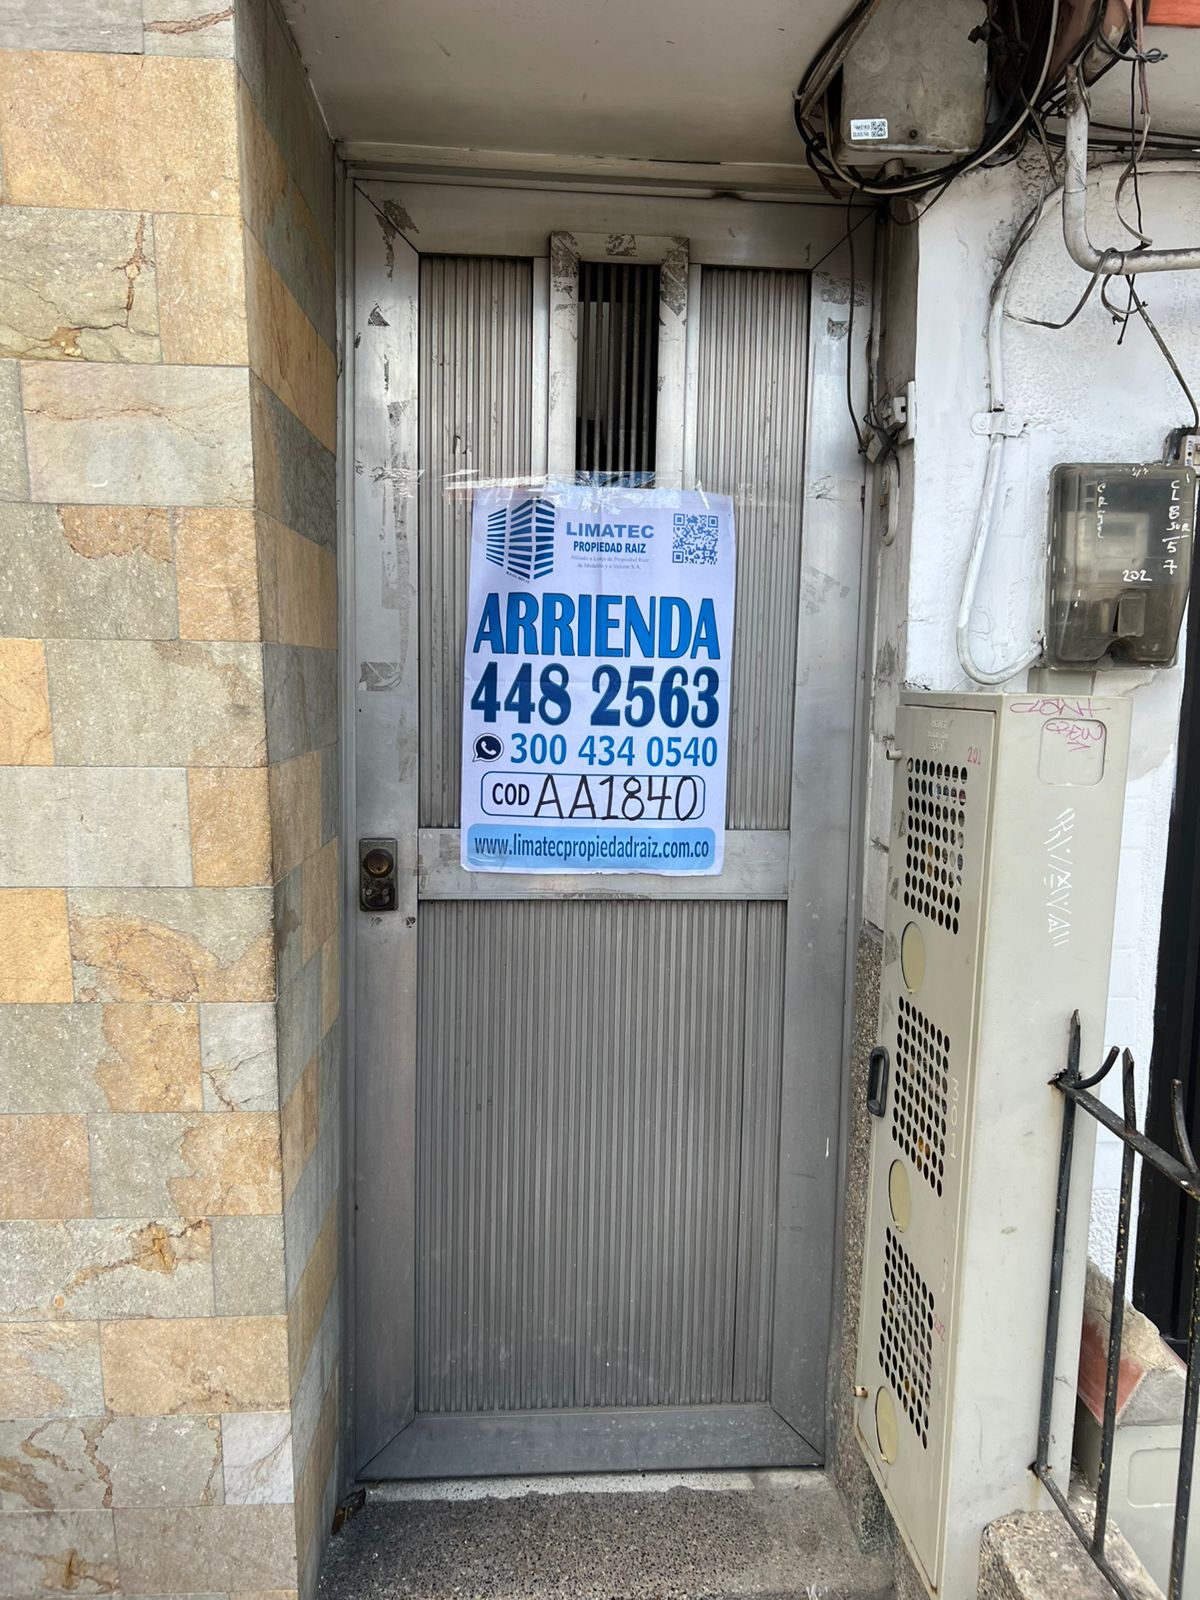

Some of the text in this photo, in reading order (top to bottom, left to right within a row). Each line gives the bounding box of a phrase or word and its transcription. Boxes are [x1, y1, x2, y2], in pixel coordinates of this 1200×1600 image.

[566, 521, 655, 539] LIMATEC
[573, 540, 647, 554] PROPIEDAD RAIZ
[1122, 569, 1153, 582] 202
[472, 592, 721, 660] ARRIENDA
[470, 661, 720, 728] 448 2563
[510, 733, 718, 767] 300 434 0540
[492, 773, 698, 821] COD AA1840
[474, 833, 710, 862] www.limatecpropiedadraiz.com.co
